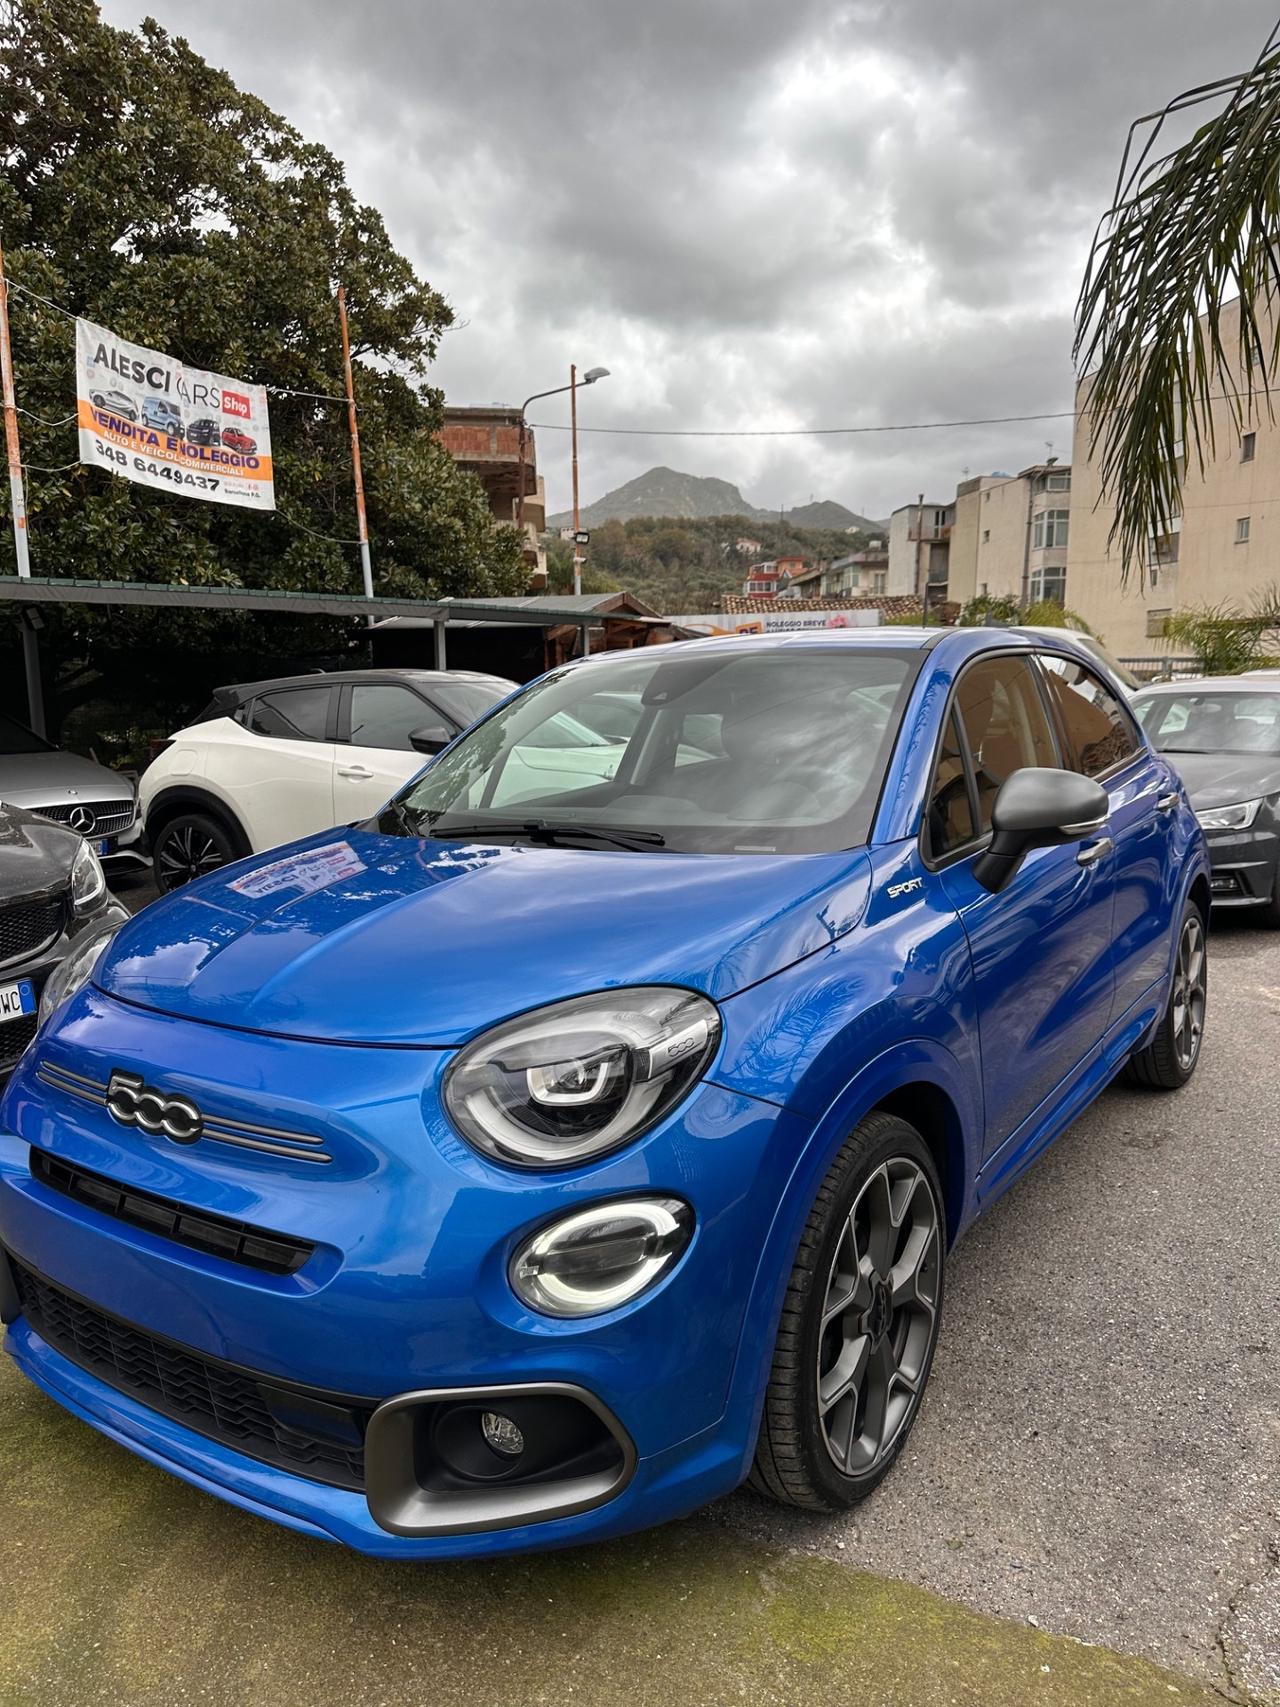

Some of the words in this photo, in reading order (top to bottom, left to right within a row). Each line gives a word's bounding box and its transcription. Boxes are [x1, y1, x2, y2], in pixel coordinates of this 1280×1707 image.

[94, 343, 171, 392] ALESCI
[176, 376, 220, 409] CARS
[90, 406, 160, 447] VENDITA
[167, 437, 178, 451] E
[180, 440, 260, 469] NOLEGGIO
[103, 430, 129, 446] AUTO
[131, 440, 138, 450] E
[140, 444, 180, 462] VEICOL
[96, 439, 128, 466] 348
[134, 457, 220, 491] 6449437
[766, 620, 802, 628] NOLEGGIO
[803, 619, 826, 627] BREVE
[887, 877, 923, 899] SPORT
[667, 1037, 696, 1058] 500
[108, 1075, 201, 1138] 500
